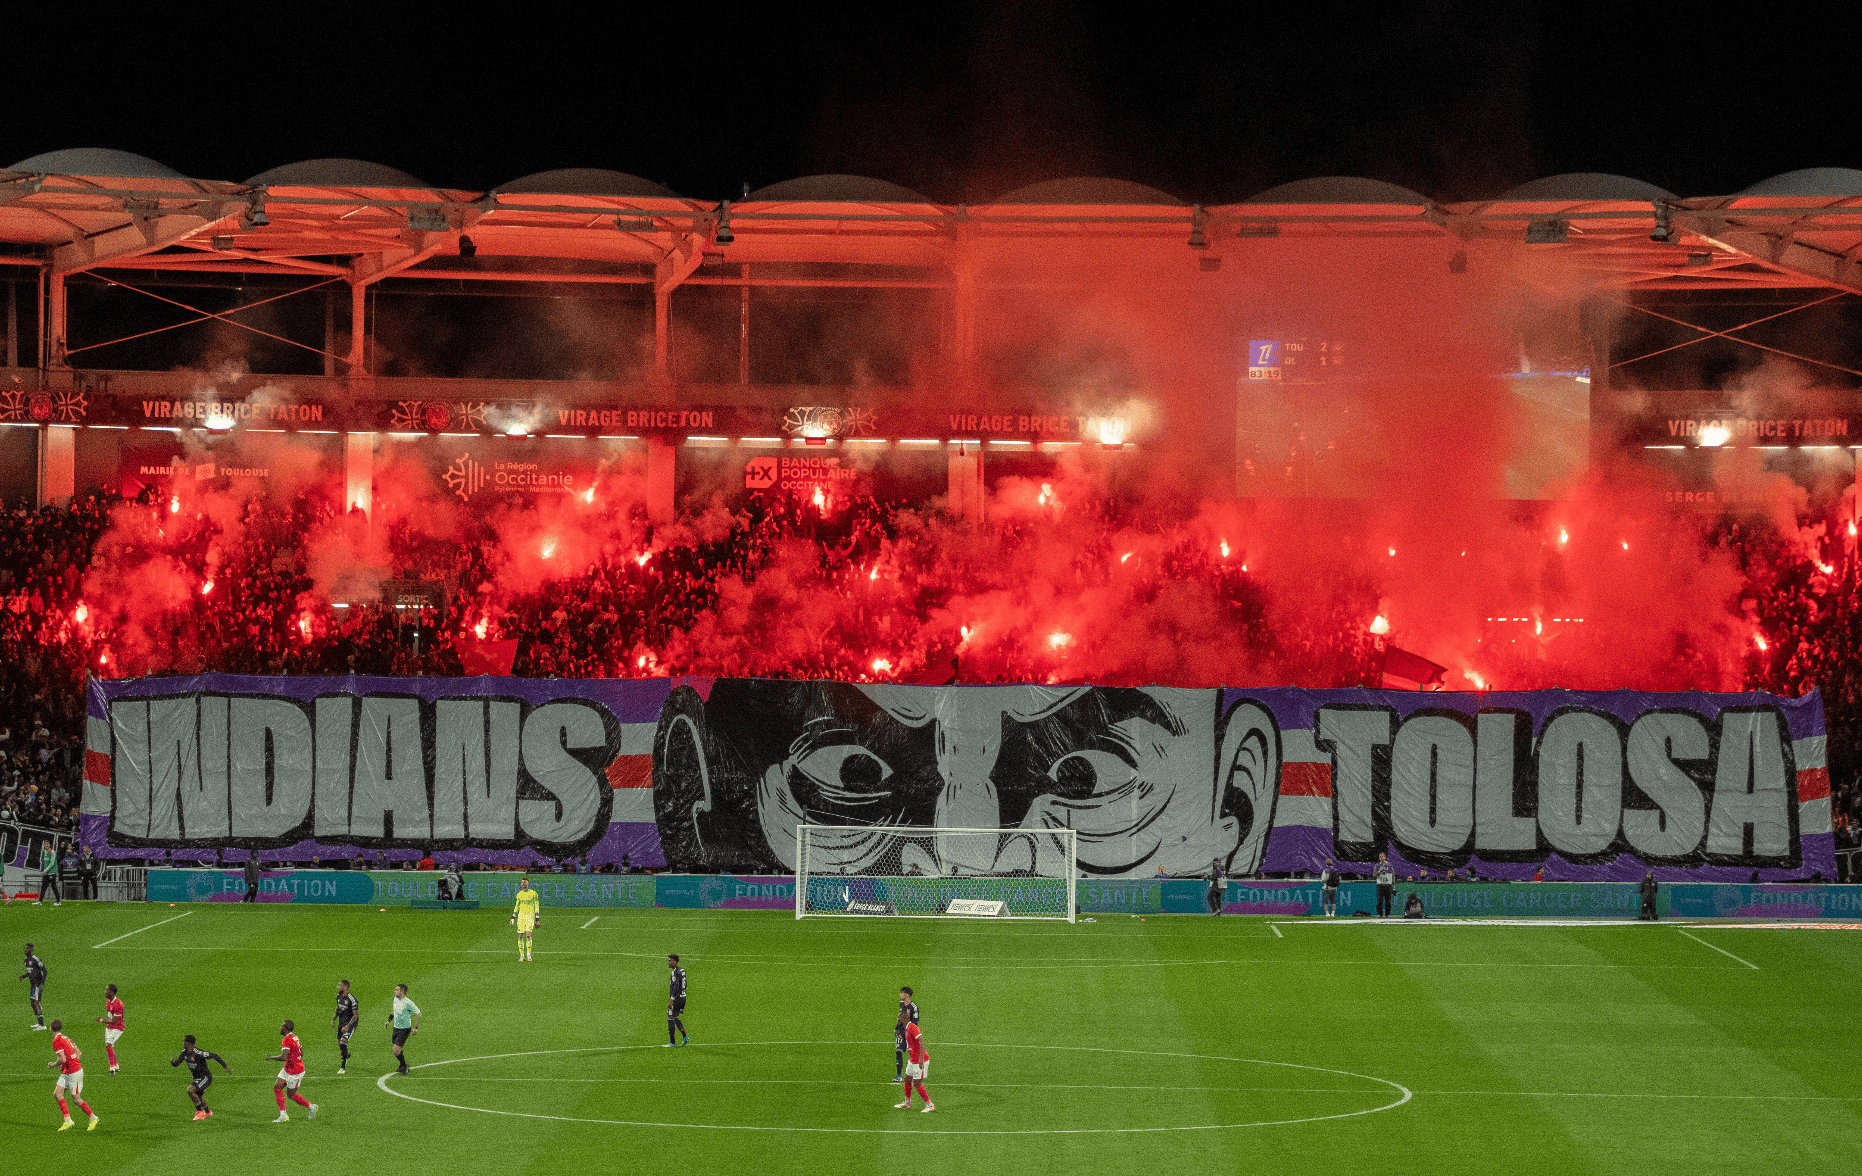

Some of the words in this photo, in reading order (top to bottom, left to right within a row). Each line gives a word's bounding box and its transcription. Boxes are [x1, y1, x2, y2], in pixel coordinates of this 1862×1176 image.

[1320, 342, 1327, 352] 2
[143, 401, 206, 419] VIRAGE
[211, 402, 262, 420] BRICE
[267, 404, 322, 421] TATON
[558, 409, 622, 427] VIRAGE
[950, 414, 1013, 432] VIRAGE
[1018, 415, 1070, 433] BRICE
[1792, 419, 1848, 437] TATON
[140, 465, 175, 475] MAIRIE
[178, 466, 190, 475] DE
[220, 467, 269, 477] TOULOUSE
[495, 462, 505, 470] La
[507, 462, 537, 471] Région
[781, 457, 838, 469] BANQUE
[495, 471, 573, 485] Occitanie
[781, 468, 858, 479] POPULAIRE
[781, 481, 834, 490] OCCITANE
[397, 594, 429, 603] SORTE
[109, 694, 607, 844] INDIANS
[1317, 706, 1796, 862] TOLOSA
[222, 878, 337, 898] FODATION
[374, 880, 478, 899] TOULOE
[1236, 888, 1352, 907] FONDATIN
